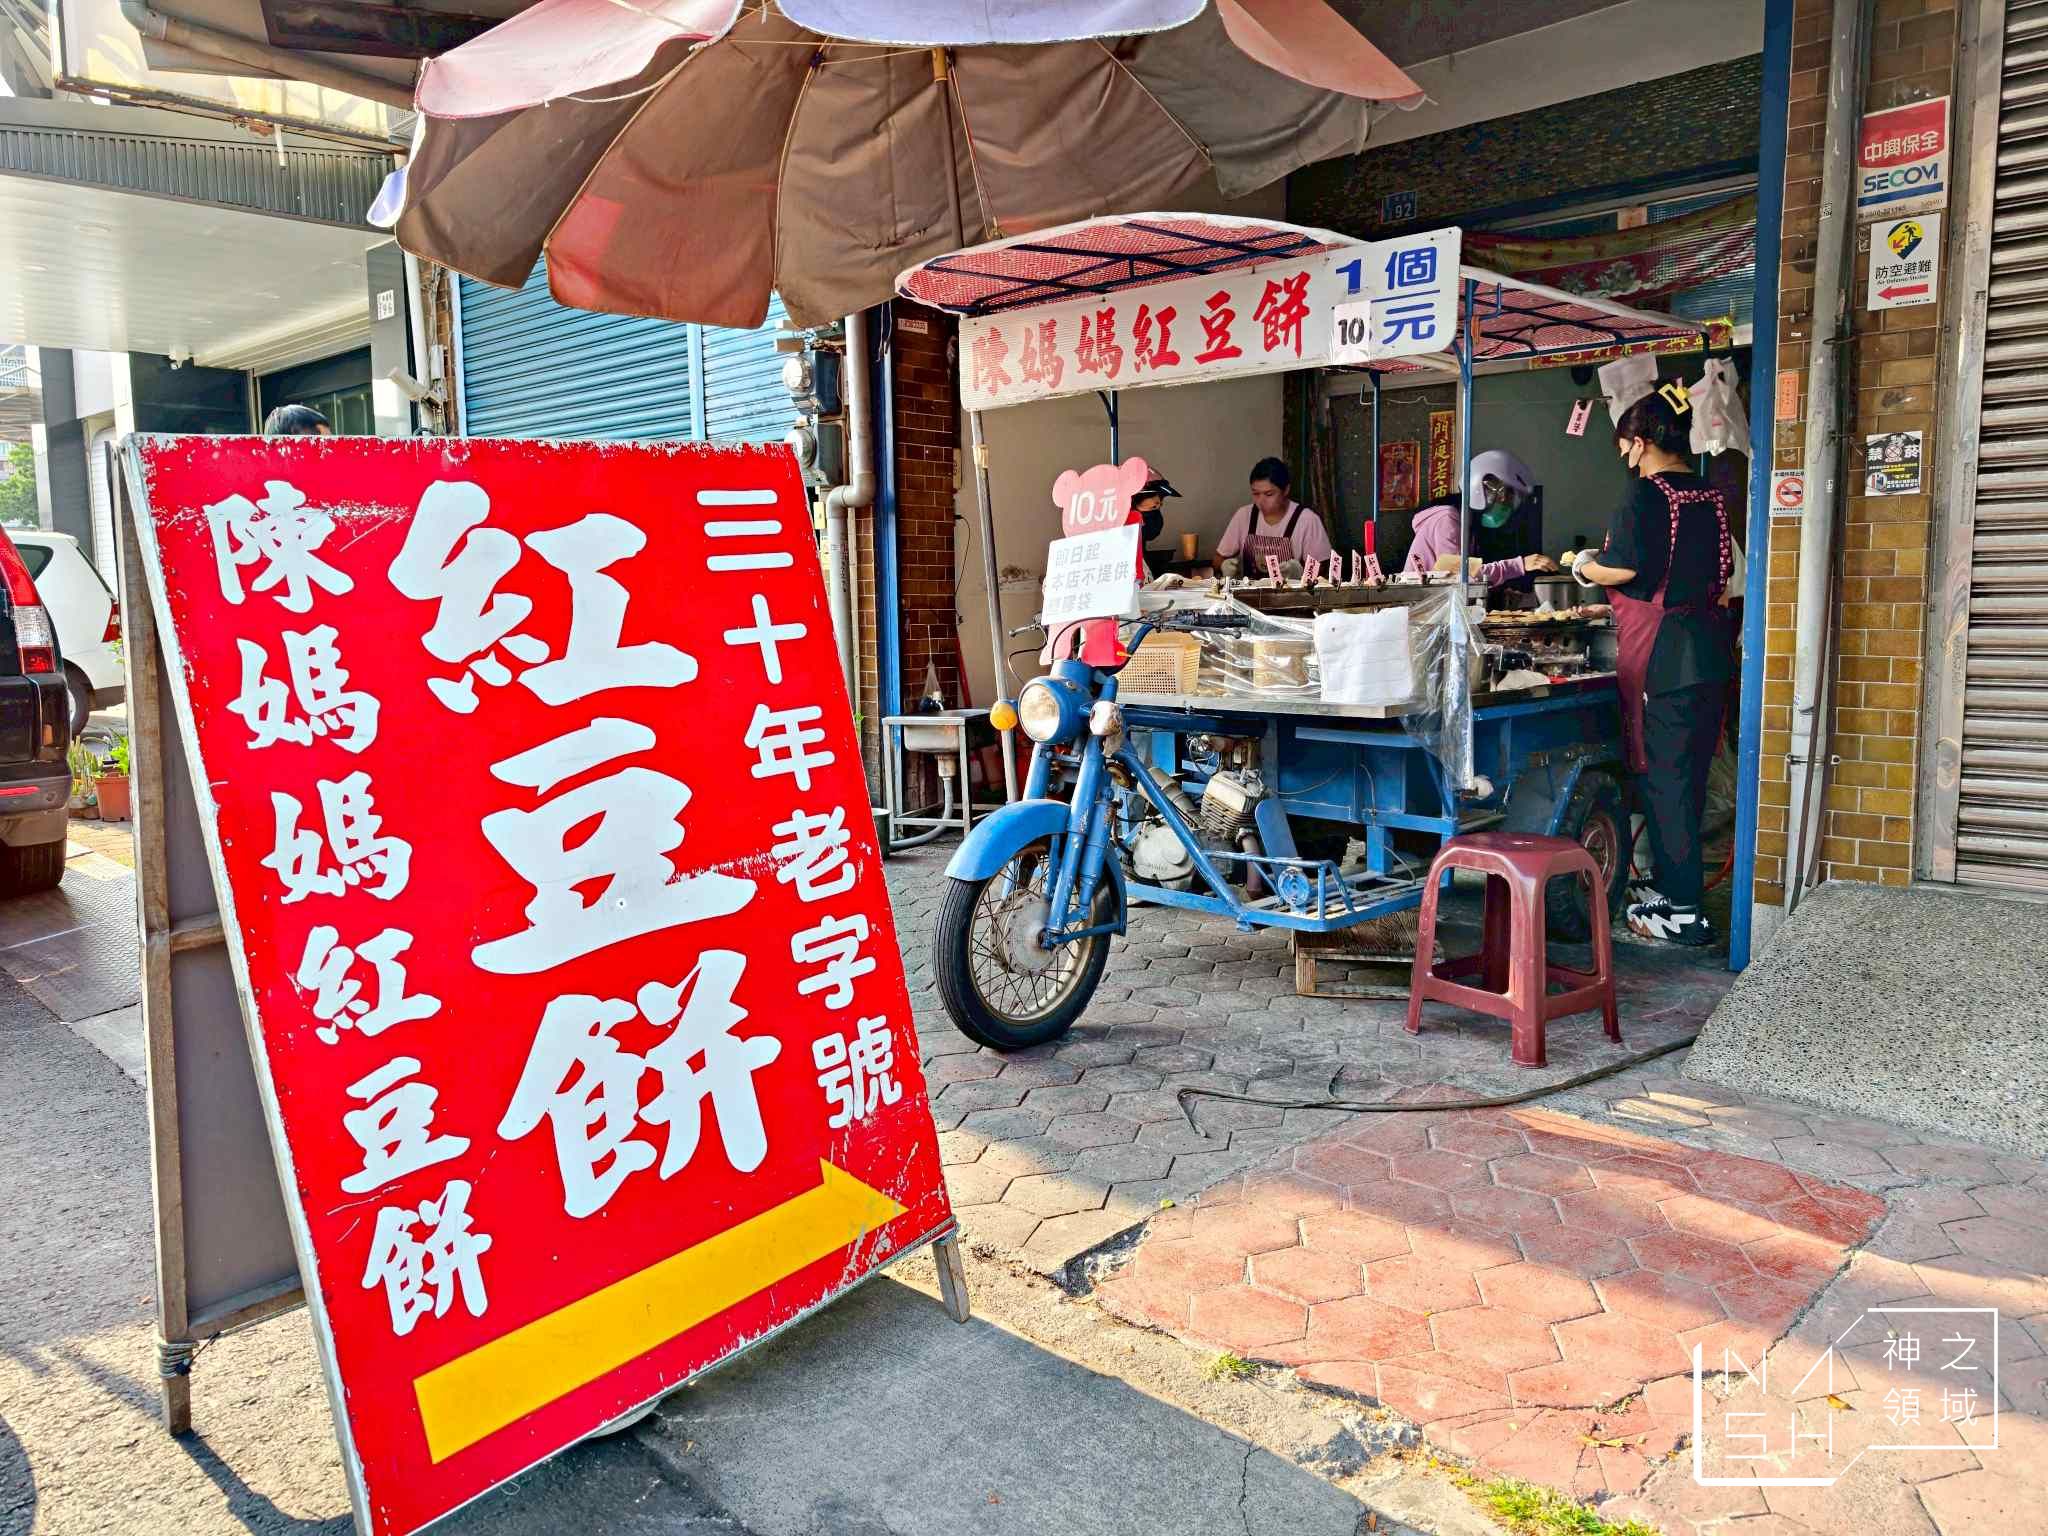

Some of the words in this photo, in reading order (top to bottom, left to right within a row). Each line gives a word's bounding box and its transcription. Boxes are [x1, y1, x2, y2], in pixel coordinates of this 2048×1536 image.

[1864, 130, 1939, 162] 中興保全
[1863, 162, 1938, 194] SECOM
[1875, 259, 1932, 280] 防空避難
[971, 271, 1311, 396] 陳媽媽紅豆餅
[1432, 421, 1451, 498] 門庭若市
[1069, 488, 1119, 526] 10元
[1052, 561, 1129, 591] 本店不提供
[697, 489, 903, 1130] 三十年老字號
[388, 480, 782, 1219] 紅豆餅
[203, 480, 493, 1336] 陳媽媽紅豆餅
